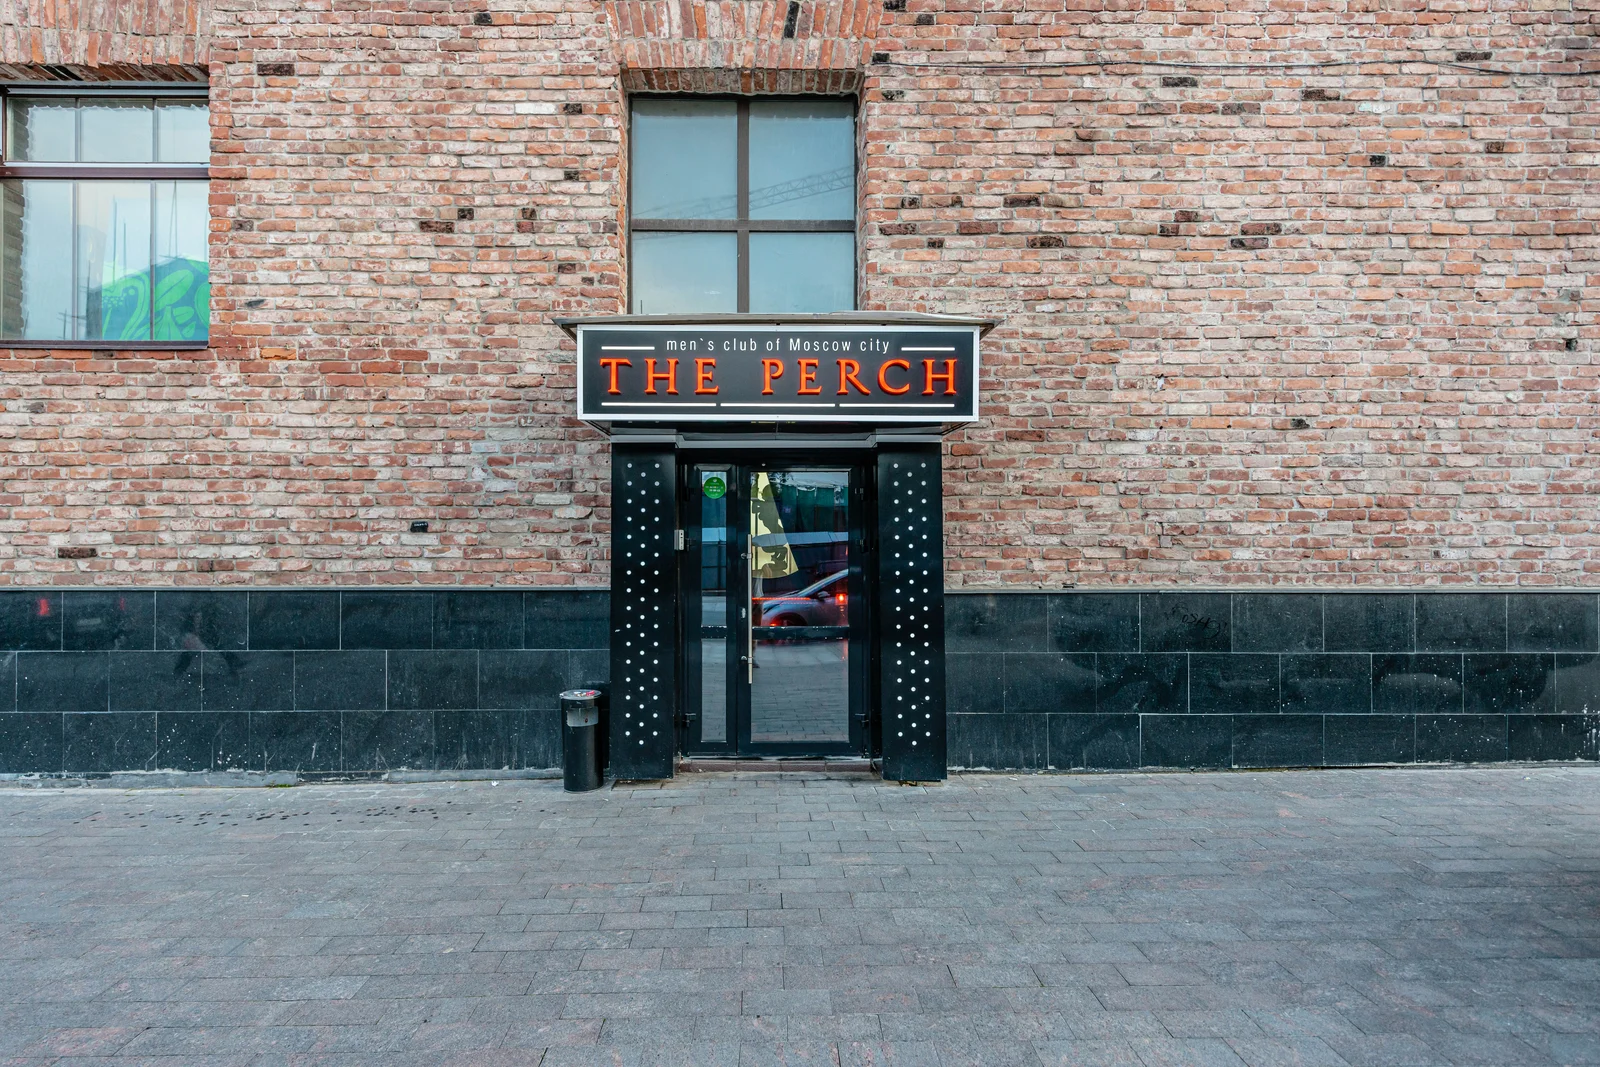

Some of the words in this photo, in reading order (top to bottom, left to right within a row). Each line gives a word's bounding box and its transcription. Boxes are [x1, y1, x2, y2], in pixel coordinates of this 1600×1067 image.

[724, 337, 757, 352] club
[766, 337, 781, 352] of
[790, 337, 851, 352] Moscow
[860, 337, 891, 355] city
[600, 358, 719, 395] THE
[762, 358, 957, 395] PERCH
